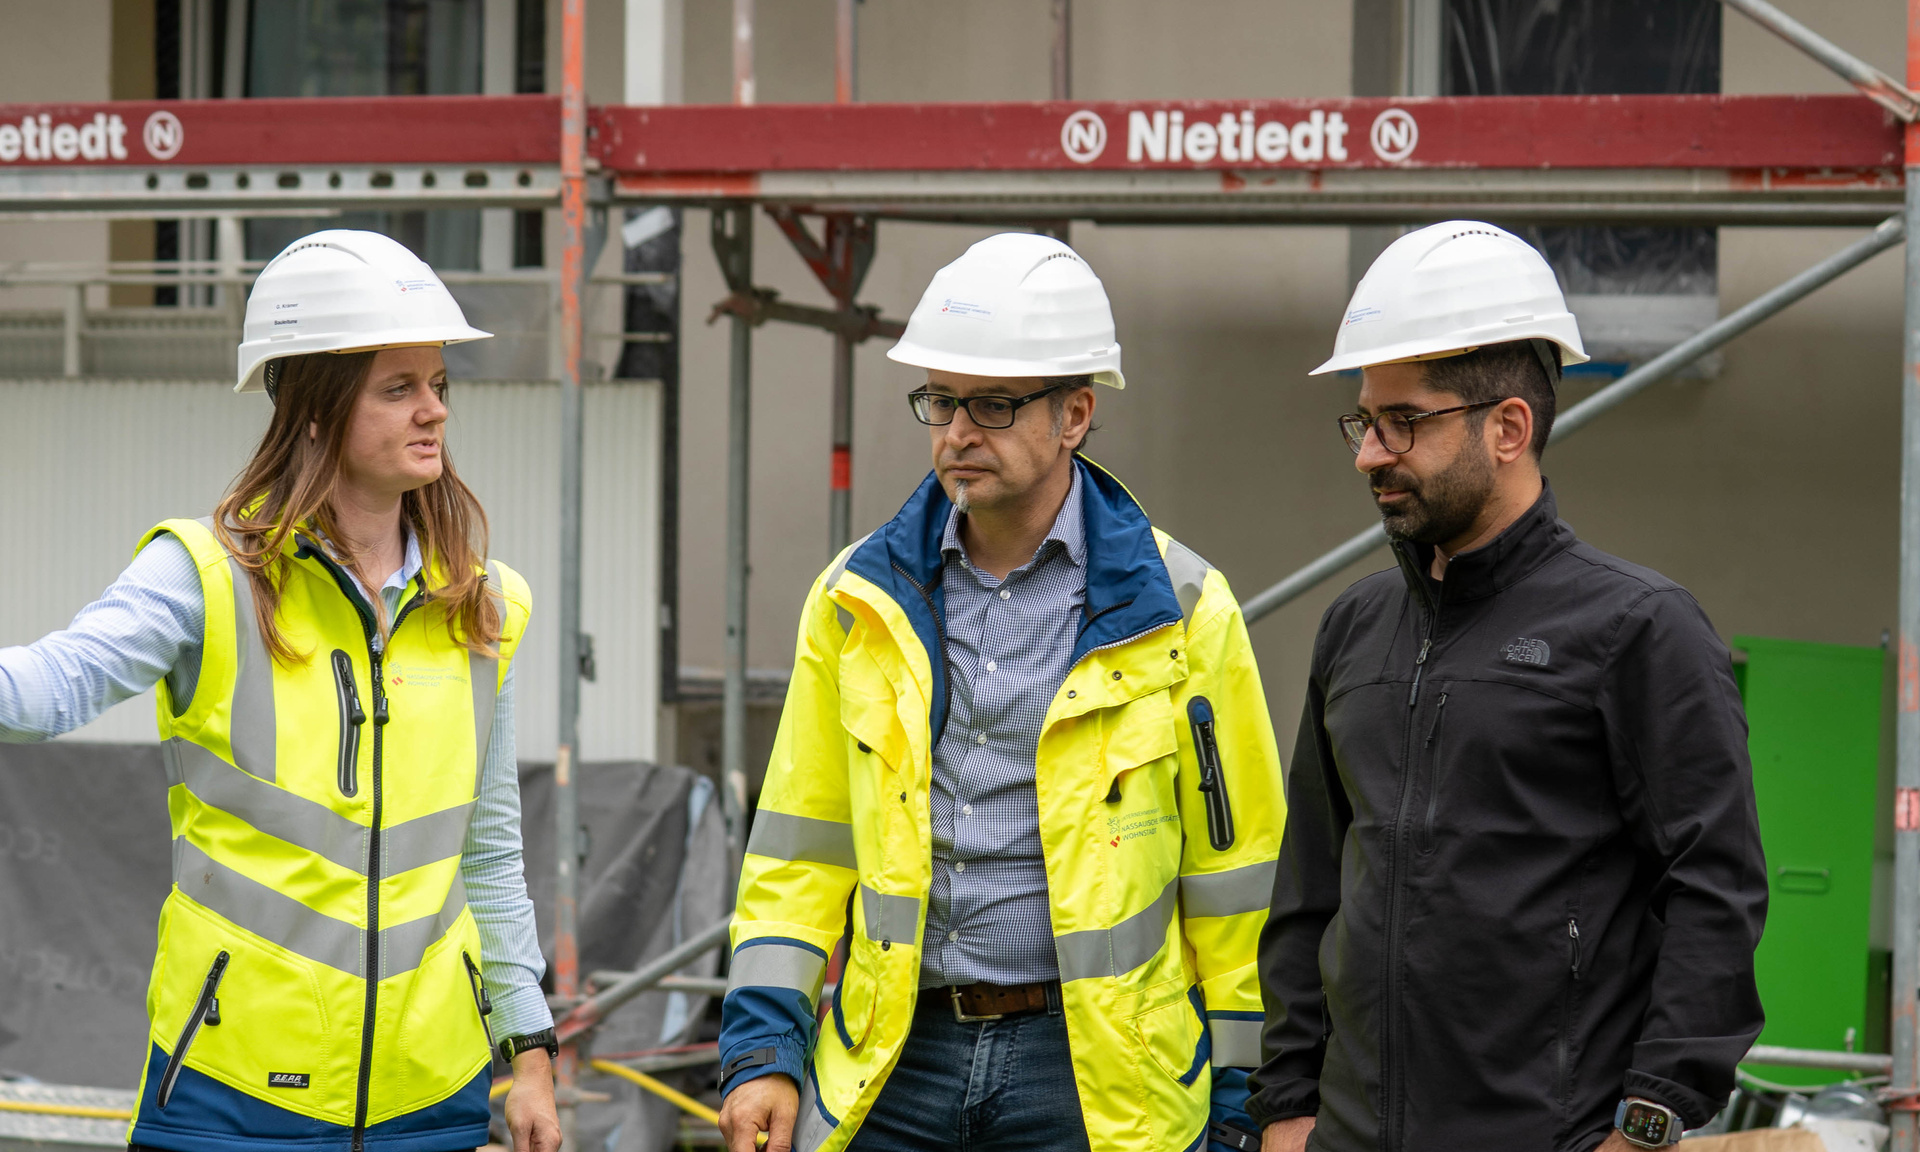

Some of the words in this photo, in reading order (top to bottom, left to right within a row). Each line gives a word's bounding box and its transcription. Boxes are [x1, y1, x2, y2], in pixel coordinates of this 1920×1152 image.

[1127, 109, 1350, 163] Nietiedt
[1518, 637, 1538, 648] THE
[1506, 652, 1531, 663] FACE
